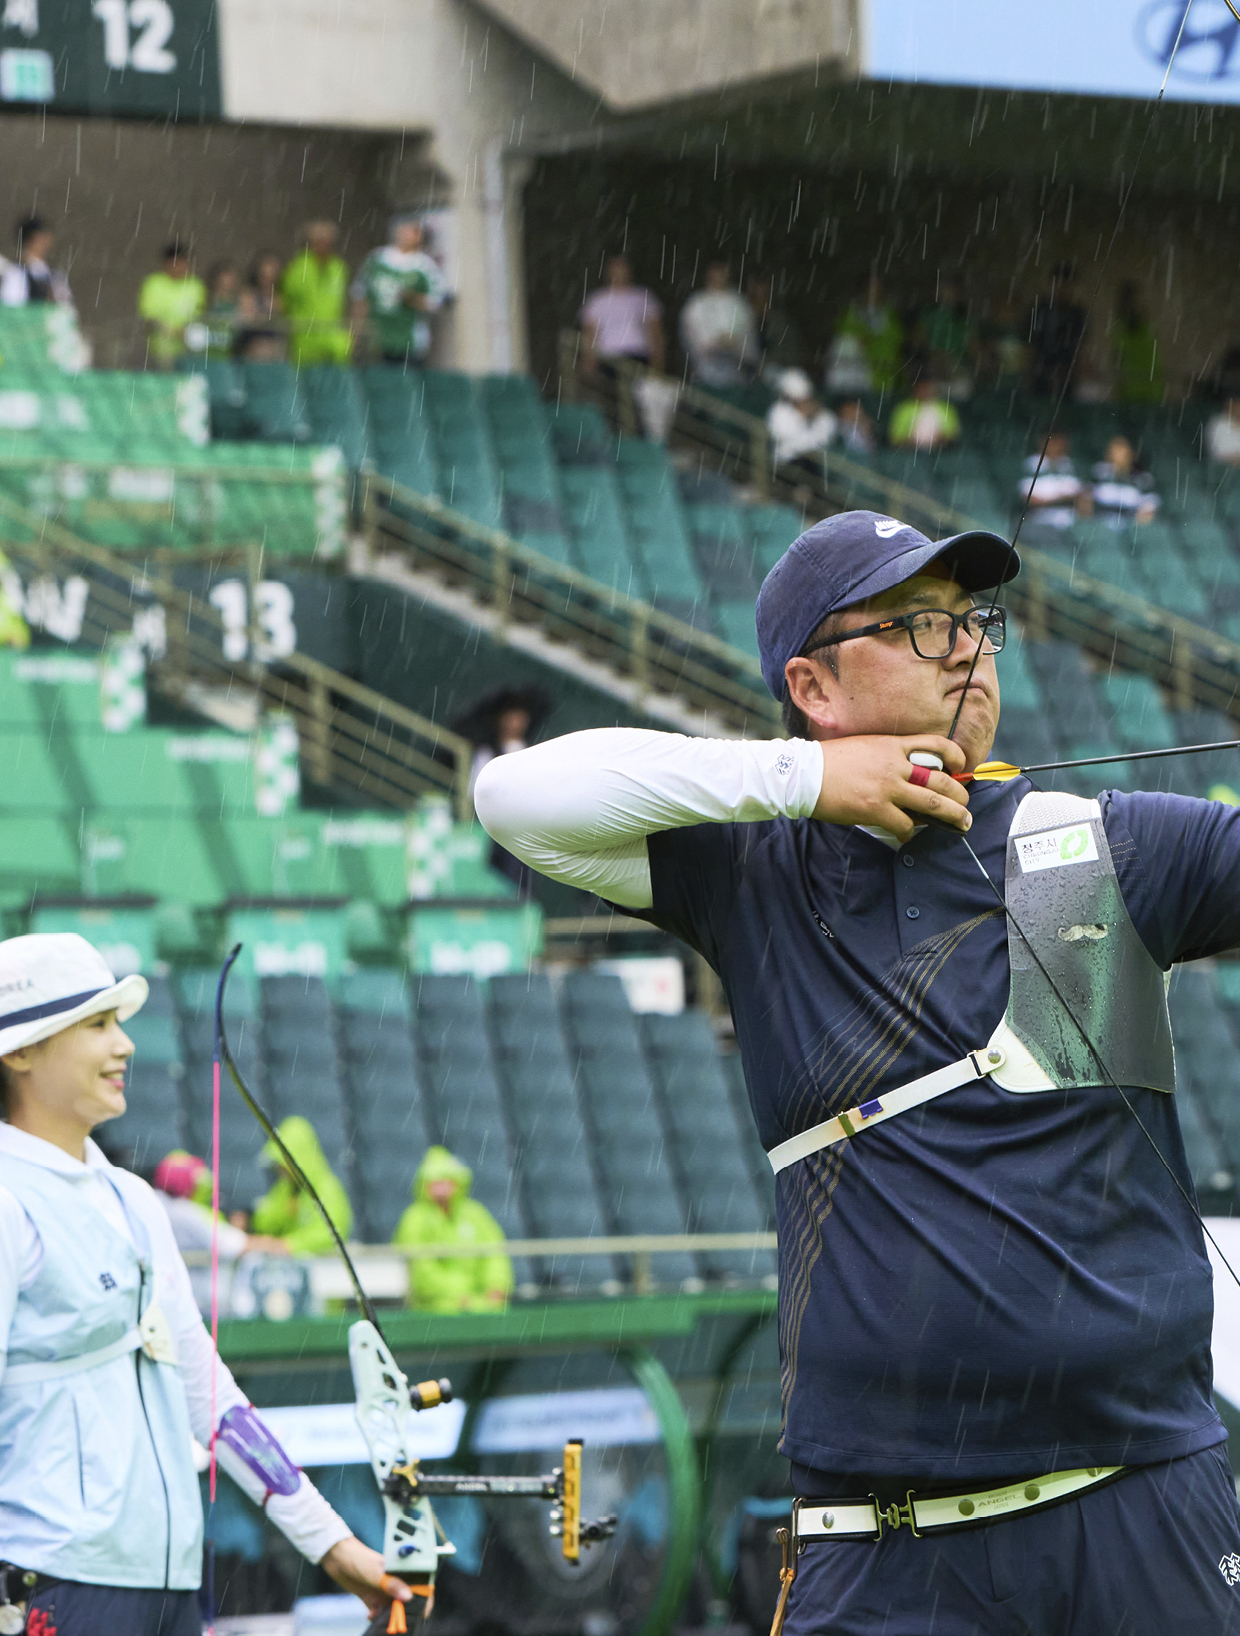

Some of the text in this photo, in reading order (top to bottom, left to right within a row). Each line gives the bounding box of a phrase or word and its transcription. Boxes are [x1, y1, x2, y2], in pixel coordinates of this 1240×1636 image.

[92, 0, 178, 73] 12
[209, 577, 297, 663] 13
[1021, 838, 1057, 853] 청주시
